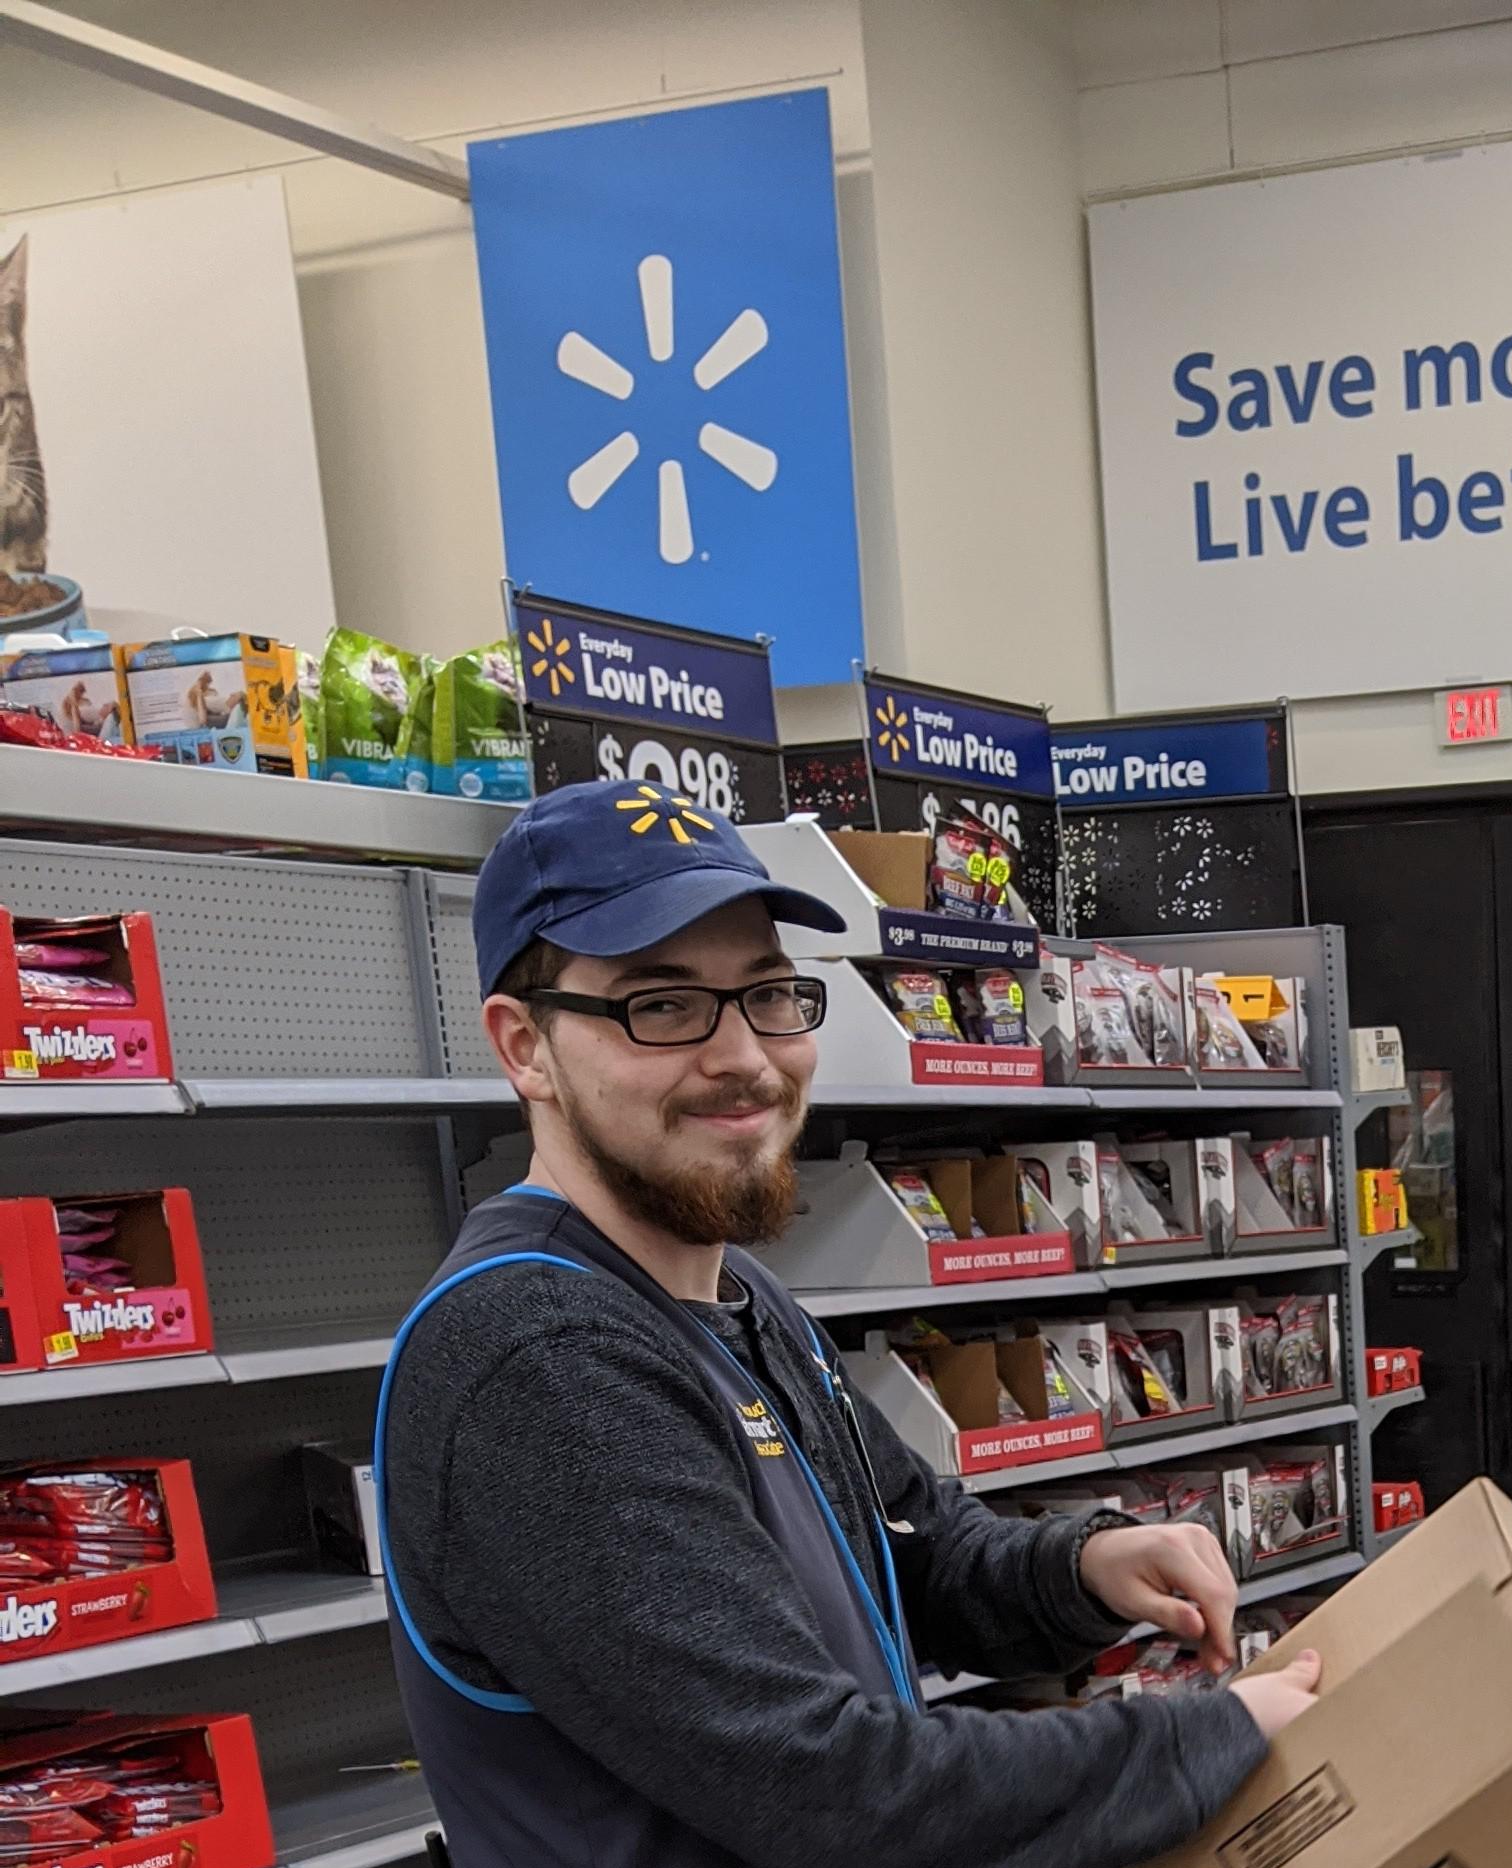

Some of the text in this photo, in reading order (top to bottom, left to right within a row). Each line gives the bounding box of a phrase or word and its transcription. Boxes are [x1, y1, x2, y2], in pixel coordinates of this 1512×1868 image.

[1173, 352, 1375, 437] Save
[1194, 472, 1370, 562] Live
[579, 633, 633, 663] Everyday
[583, 652, 724, 719] Low Price
[914, 707, 953, 731] Everyday
[1447, 689, 1498, 741] EXIT
[915, 724, 1017, 778] Low Price
[1051, 744, 1106, 761] Everyday
[1053, 753, 1207, 796] Low Price
[921, 933, 938, 946] THE
[939, 936, 976, 950] PREMIUM
[23, 1025, 117, 1062] Twizzlers
[926, 1059, 952, 1073] MORE
[991, 1062, 1014, 1076] MORE
[944, 1248, 1065, 1271] MORE OUNCES, MORE BEEF!
[63, 1299, 155, 1336] Twizzlers
[971, 1425, 1094, 1458] MORE OUNCES, MORE BEEF!
[71, 1593, 128, 1617] STRAWBERRY
